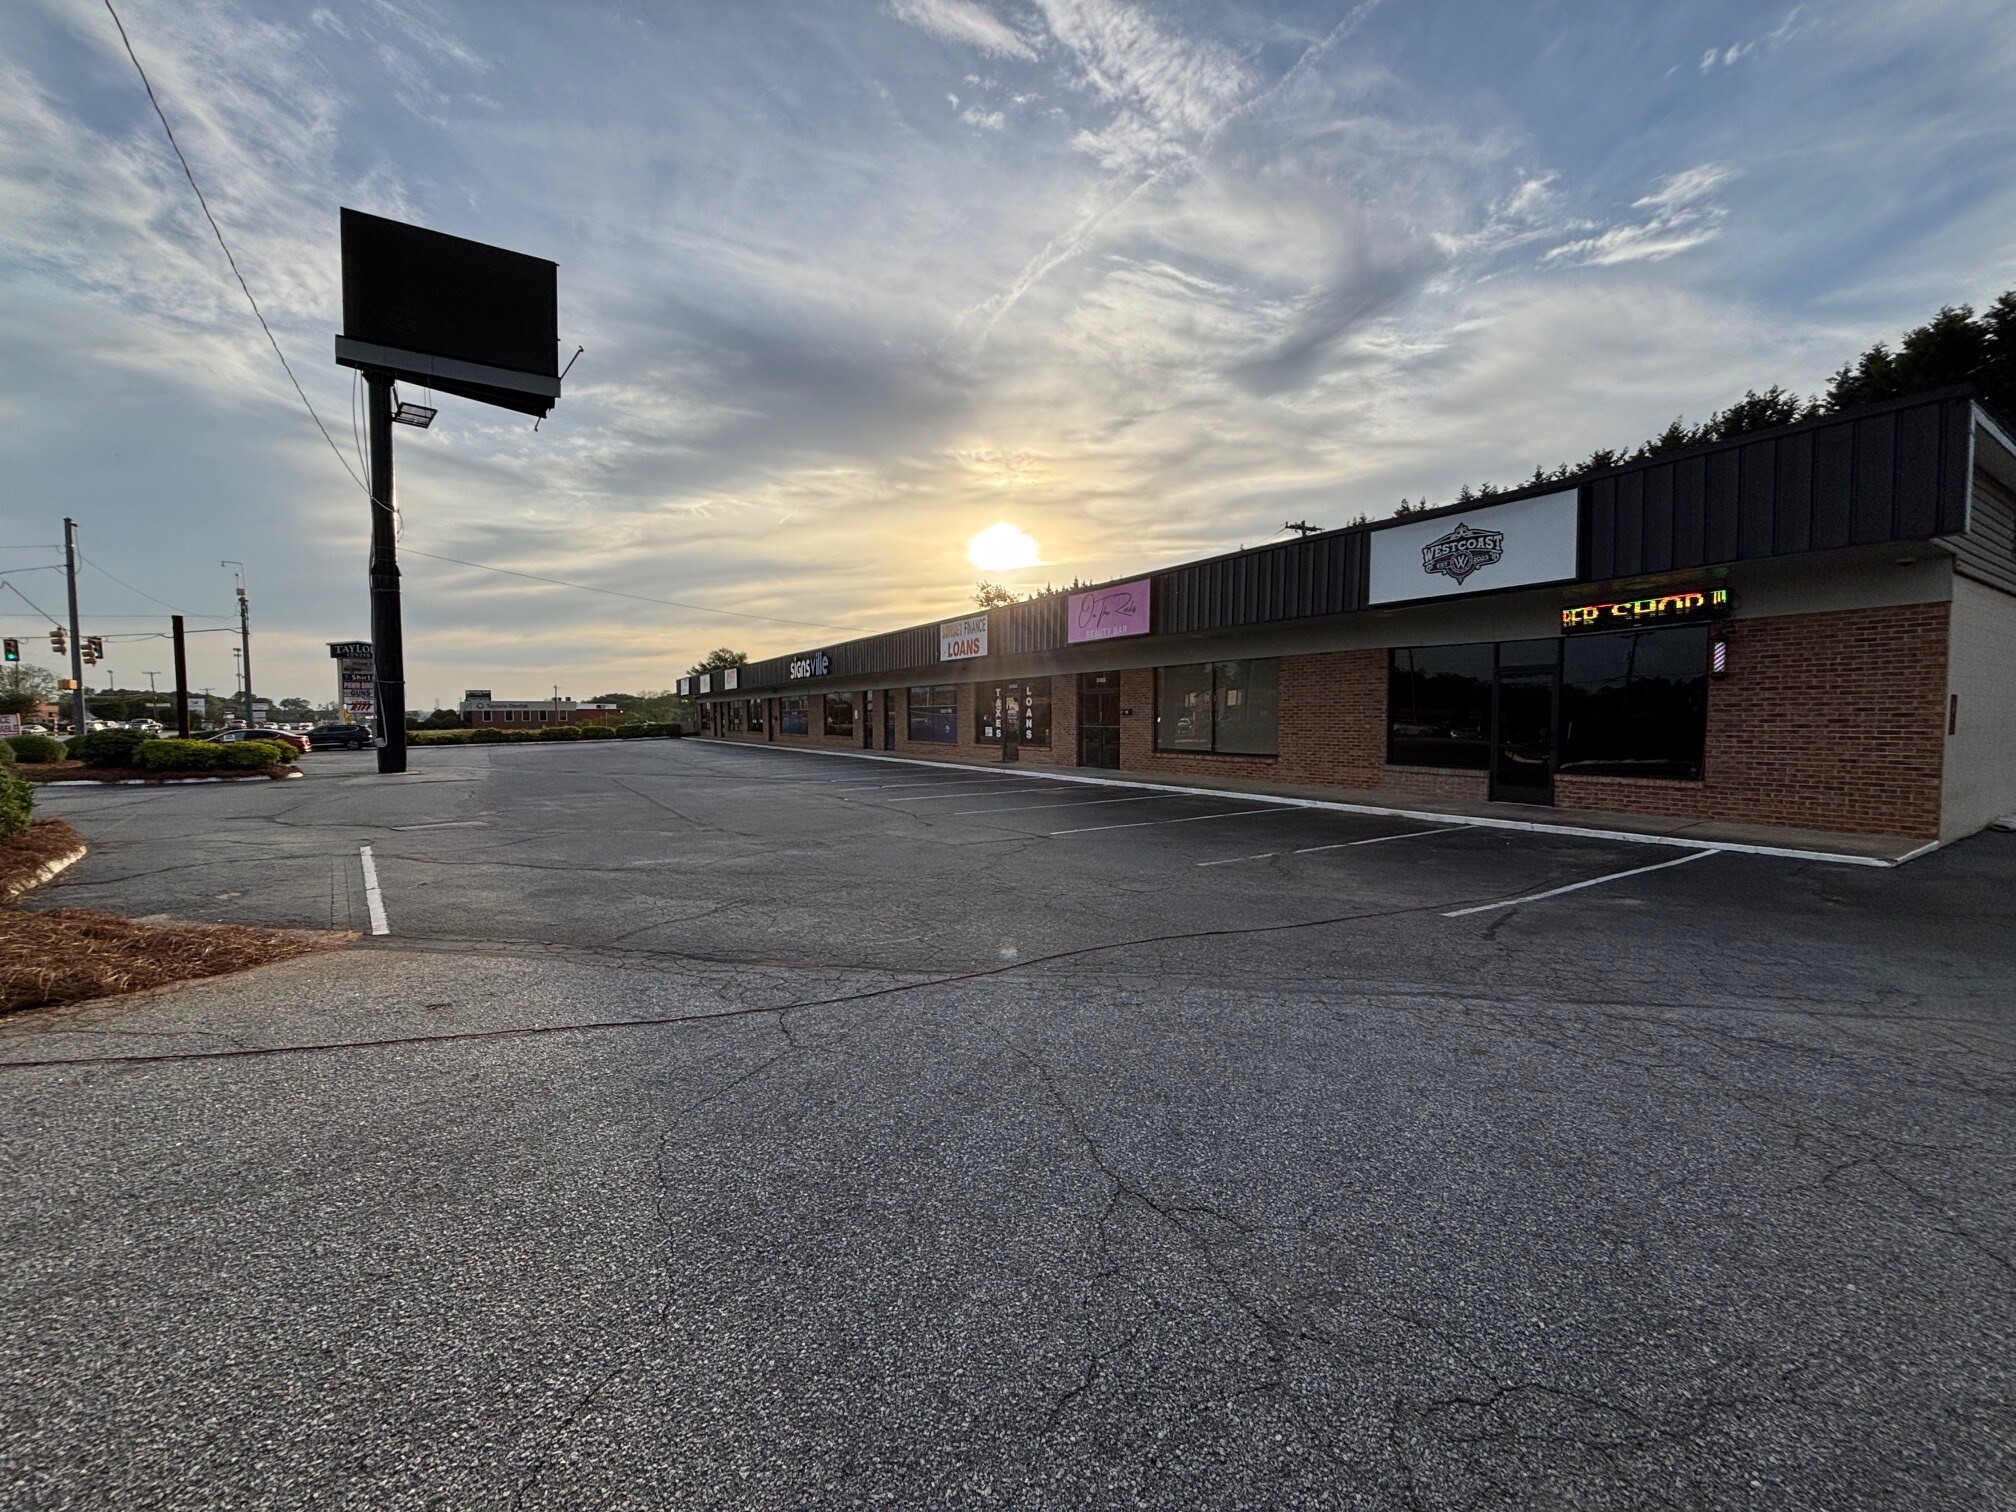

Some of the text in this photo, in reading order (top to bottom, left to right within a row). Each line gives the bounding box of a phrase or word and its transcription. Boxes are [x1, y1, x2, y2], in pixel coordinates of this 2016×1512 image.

[1423, 535, 1502, 563] WESTCOAST
[1085, 625, 1128, 639] BEAUTY BAR
[947, 637, 980, 658] LOANS
[790, 650, 829, 680] signsville
[1025, 686, 1033, 739] LOANS
